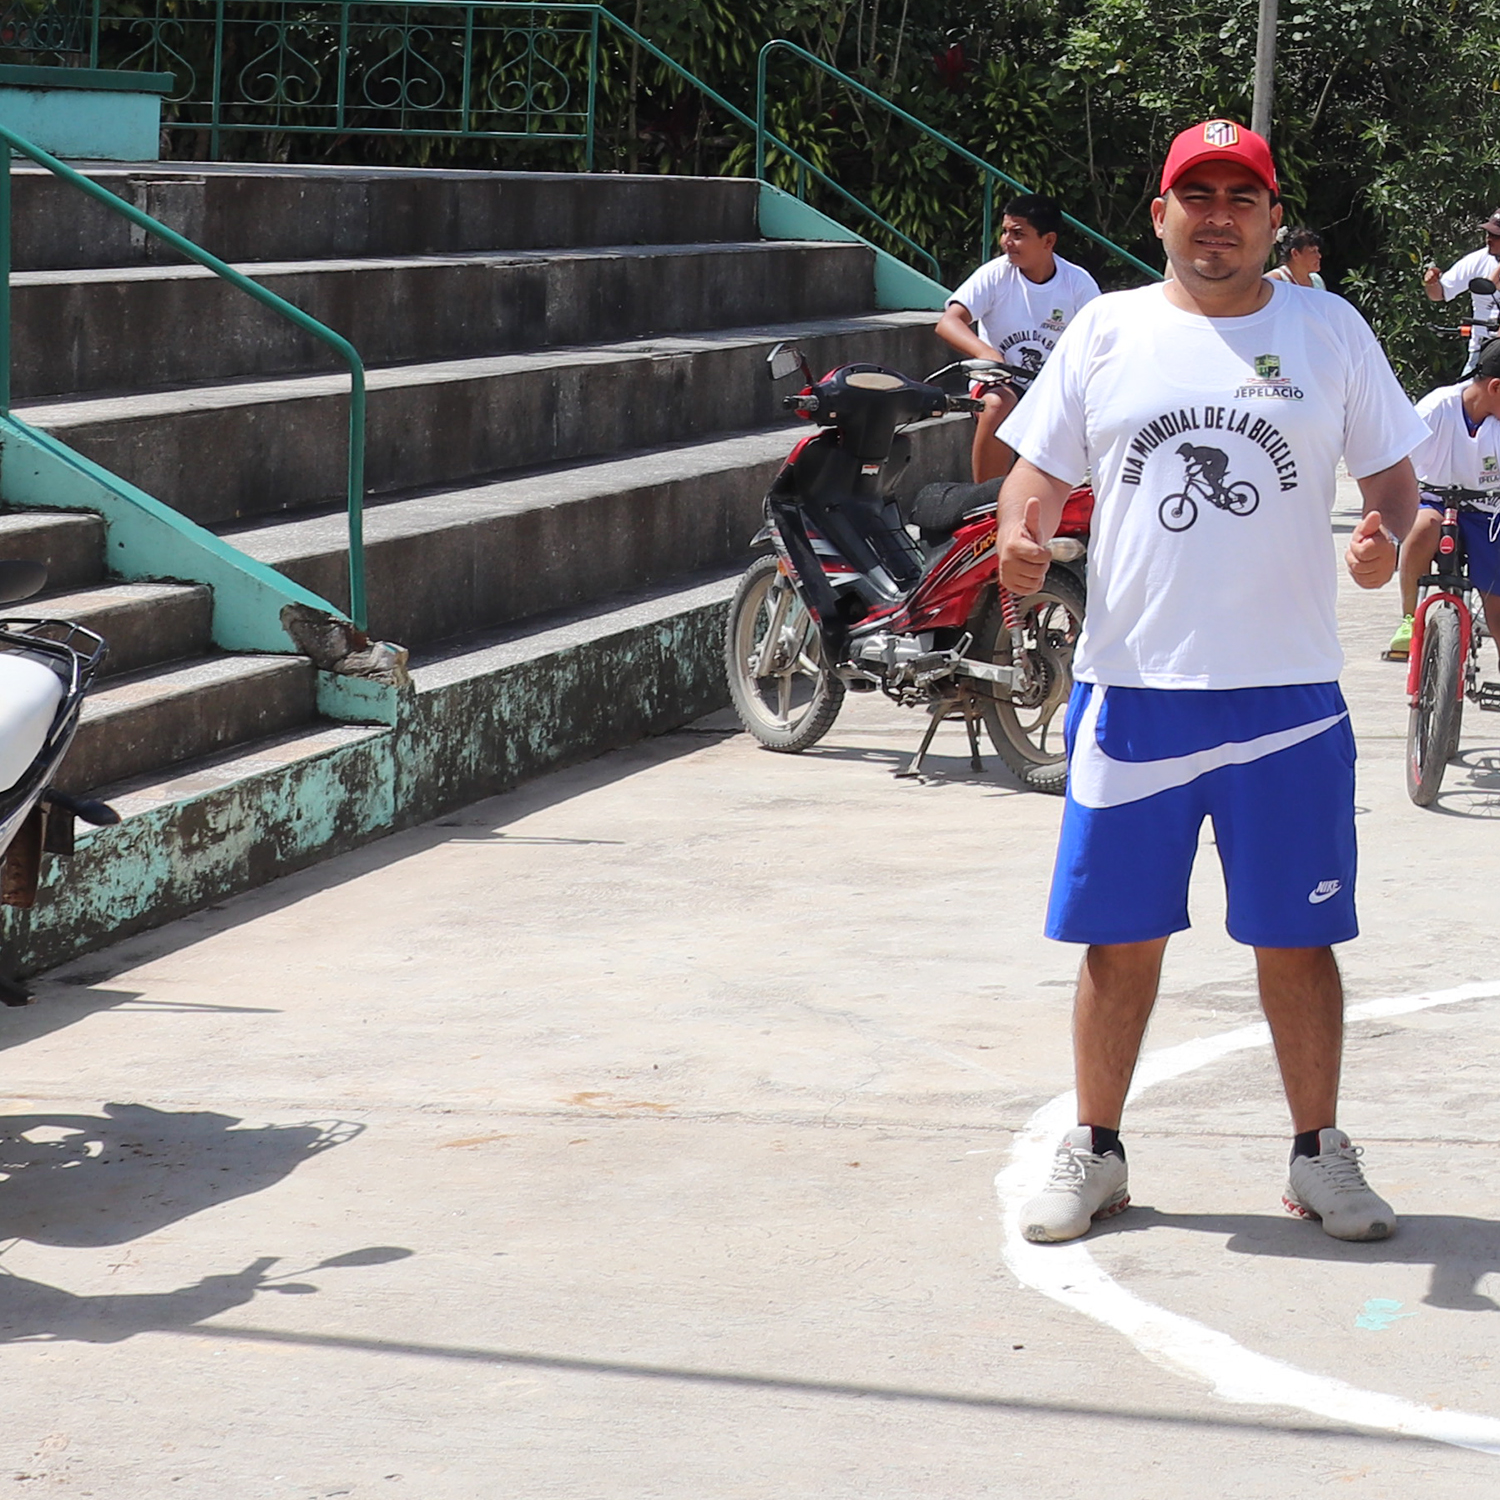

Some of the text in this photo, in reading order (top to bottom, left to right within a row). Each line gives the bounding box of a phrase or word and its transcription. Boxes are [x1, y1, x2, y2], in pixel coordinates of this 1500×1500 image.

[1234, 387, 1304, 399] JEPELACIO
[1122, 406, 1298, 492] DIA MUNDIAL DE LA BICICLETA
[1316, 879, 1339, 893] NIKE
